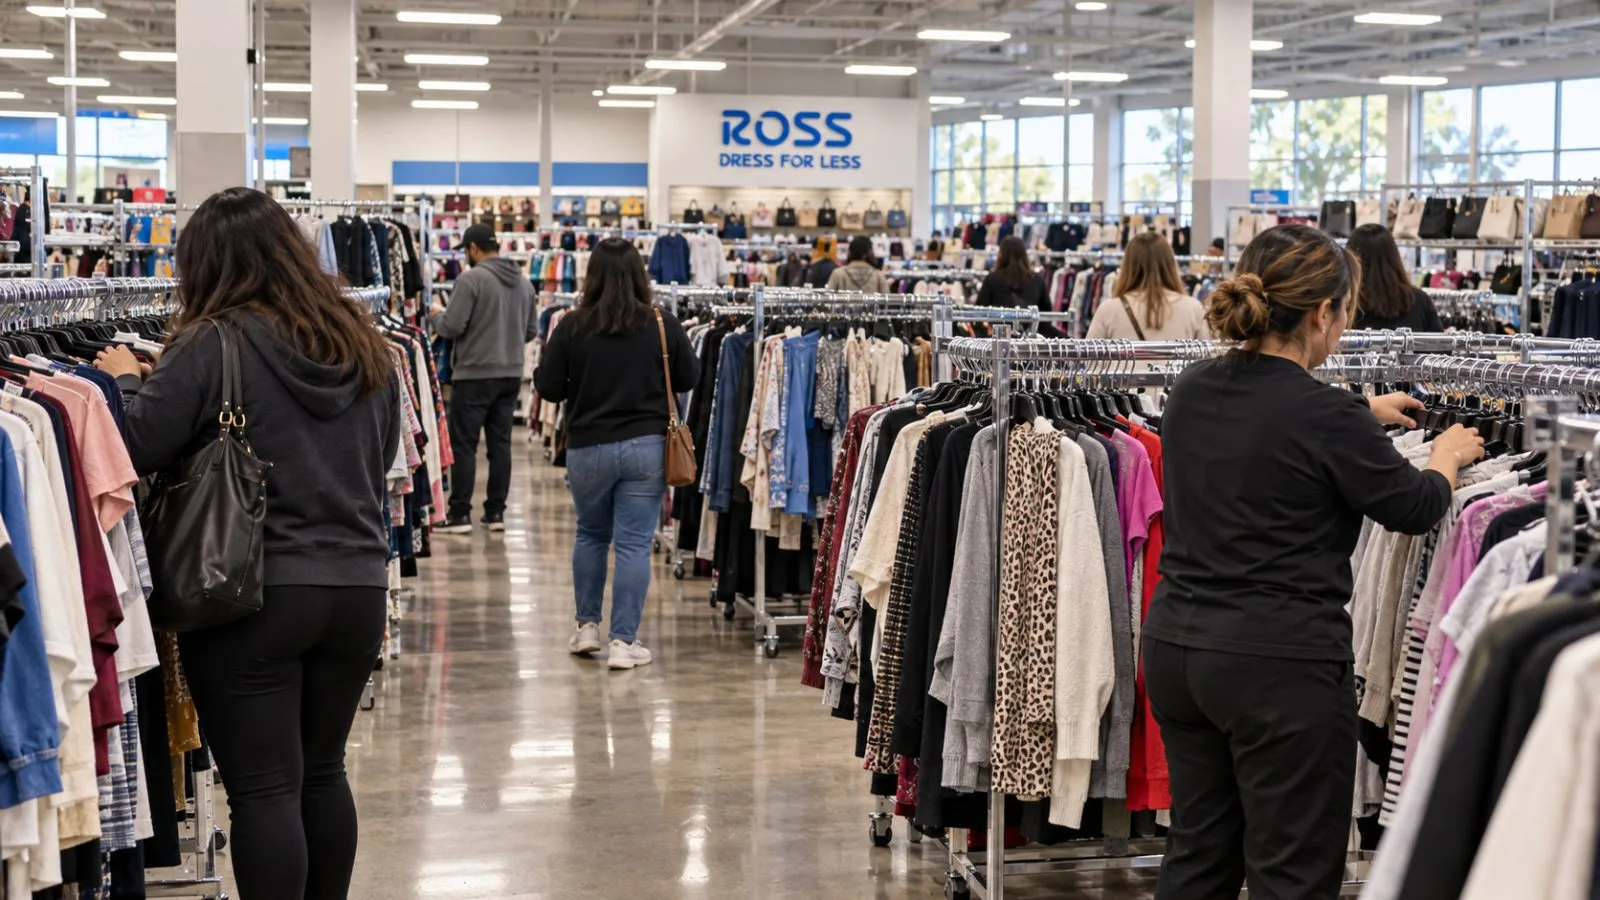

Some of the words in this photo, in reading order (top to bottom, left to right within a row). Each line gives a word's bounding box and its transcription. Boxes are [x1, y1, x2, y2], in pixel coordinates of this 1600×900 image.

[722, 109, 853, 148] ROSS
[719, 153, 774, 168] DRESS
[780, 154, 814, 168] FOR
[820, 155, 861, 169] LESS
